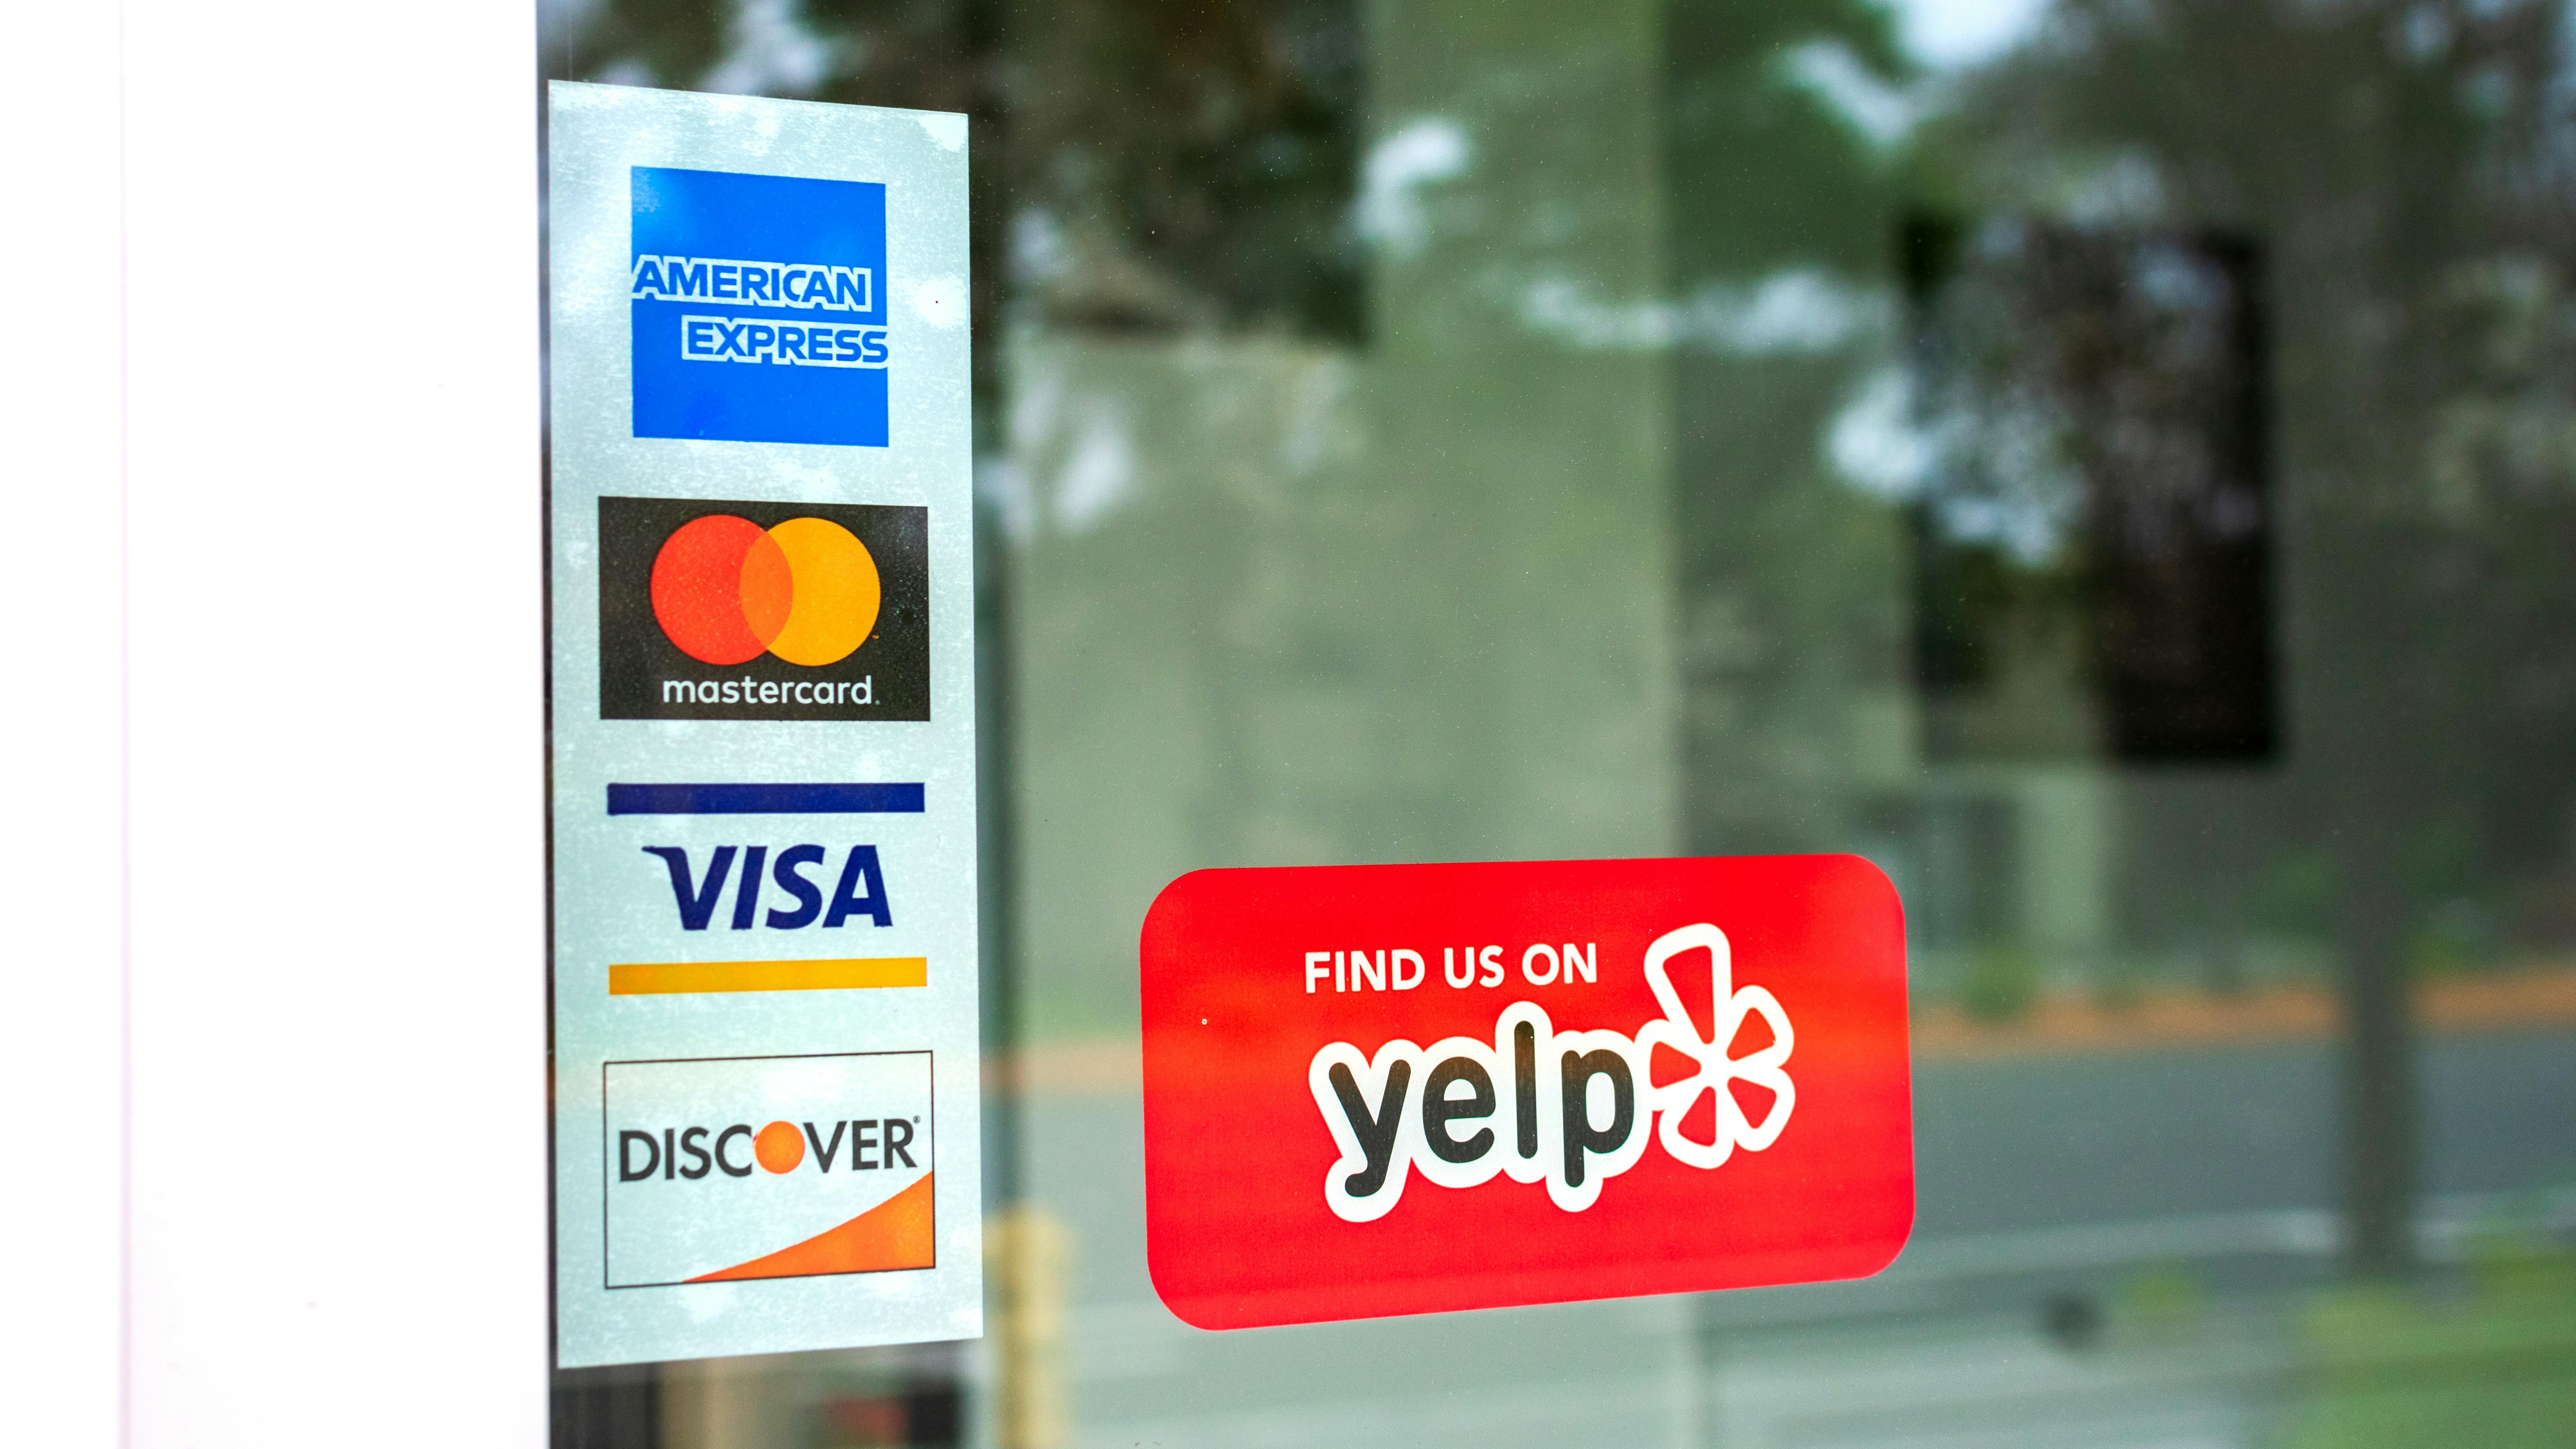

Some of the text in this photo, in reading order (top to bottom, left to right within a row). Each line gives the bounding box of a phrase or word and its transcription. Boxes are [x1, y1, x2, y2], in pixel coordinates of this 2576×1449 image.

[632, 260, 866, 306] AMERICAN
[687, 321, 889, 363] EXPRESS
[641, 844, 893, 930] VISA
[1304, 942, 1598, 993] FIND US ON
[1329, 1021, 1634, 1198] yelp
